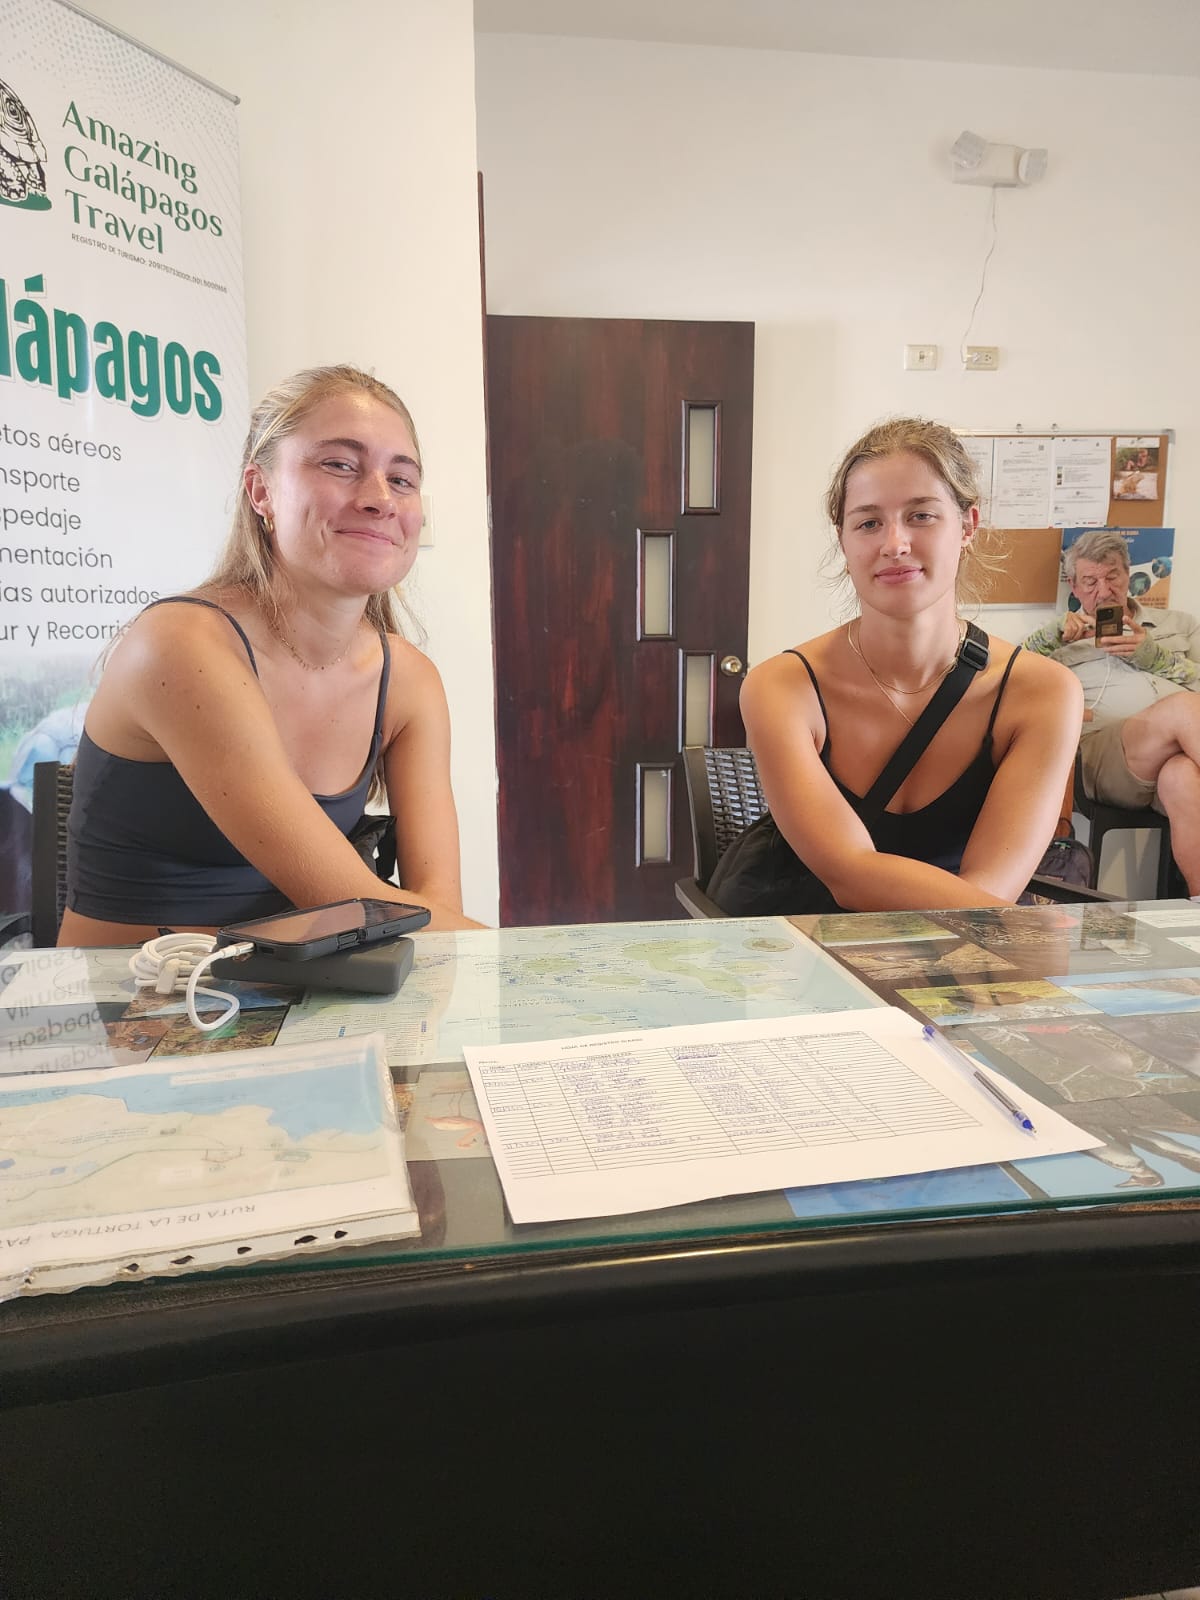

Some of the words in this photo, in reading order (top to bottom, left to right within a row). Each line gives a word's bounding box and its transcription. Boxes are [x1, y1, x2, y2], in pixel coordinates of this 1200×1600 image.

[62, 101, 198, 194] Amazing
[64, 145, 223, 237] Galápagos
[65, 189, 164, 254] Travel
[71, 233, 107, 250] REGISTRO
[108, 245, 116, 255] DE
[48, 432, 122, 461] aéreos
[0, 507, 82, 535] pedaje
[41, 584, 160, 604] autorizados
[27, 625, 40, 647] y
[48, 620, 122, 640] Recorri
[149, 1216, 170, 1227] LA
[177, 1212, 200, 1225] DE
[208, 1204, 256, 1219] RUTA
[50, 1222, 140, 1239] TORTUGA
